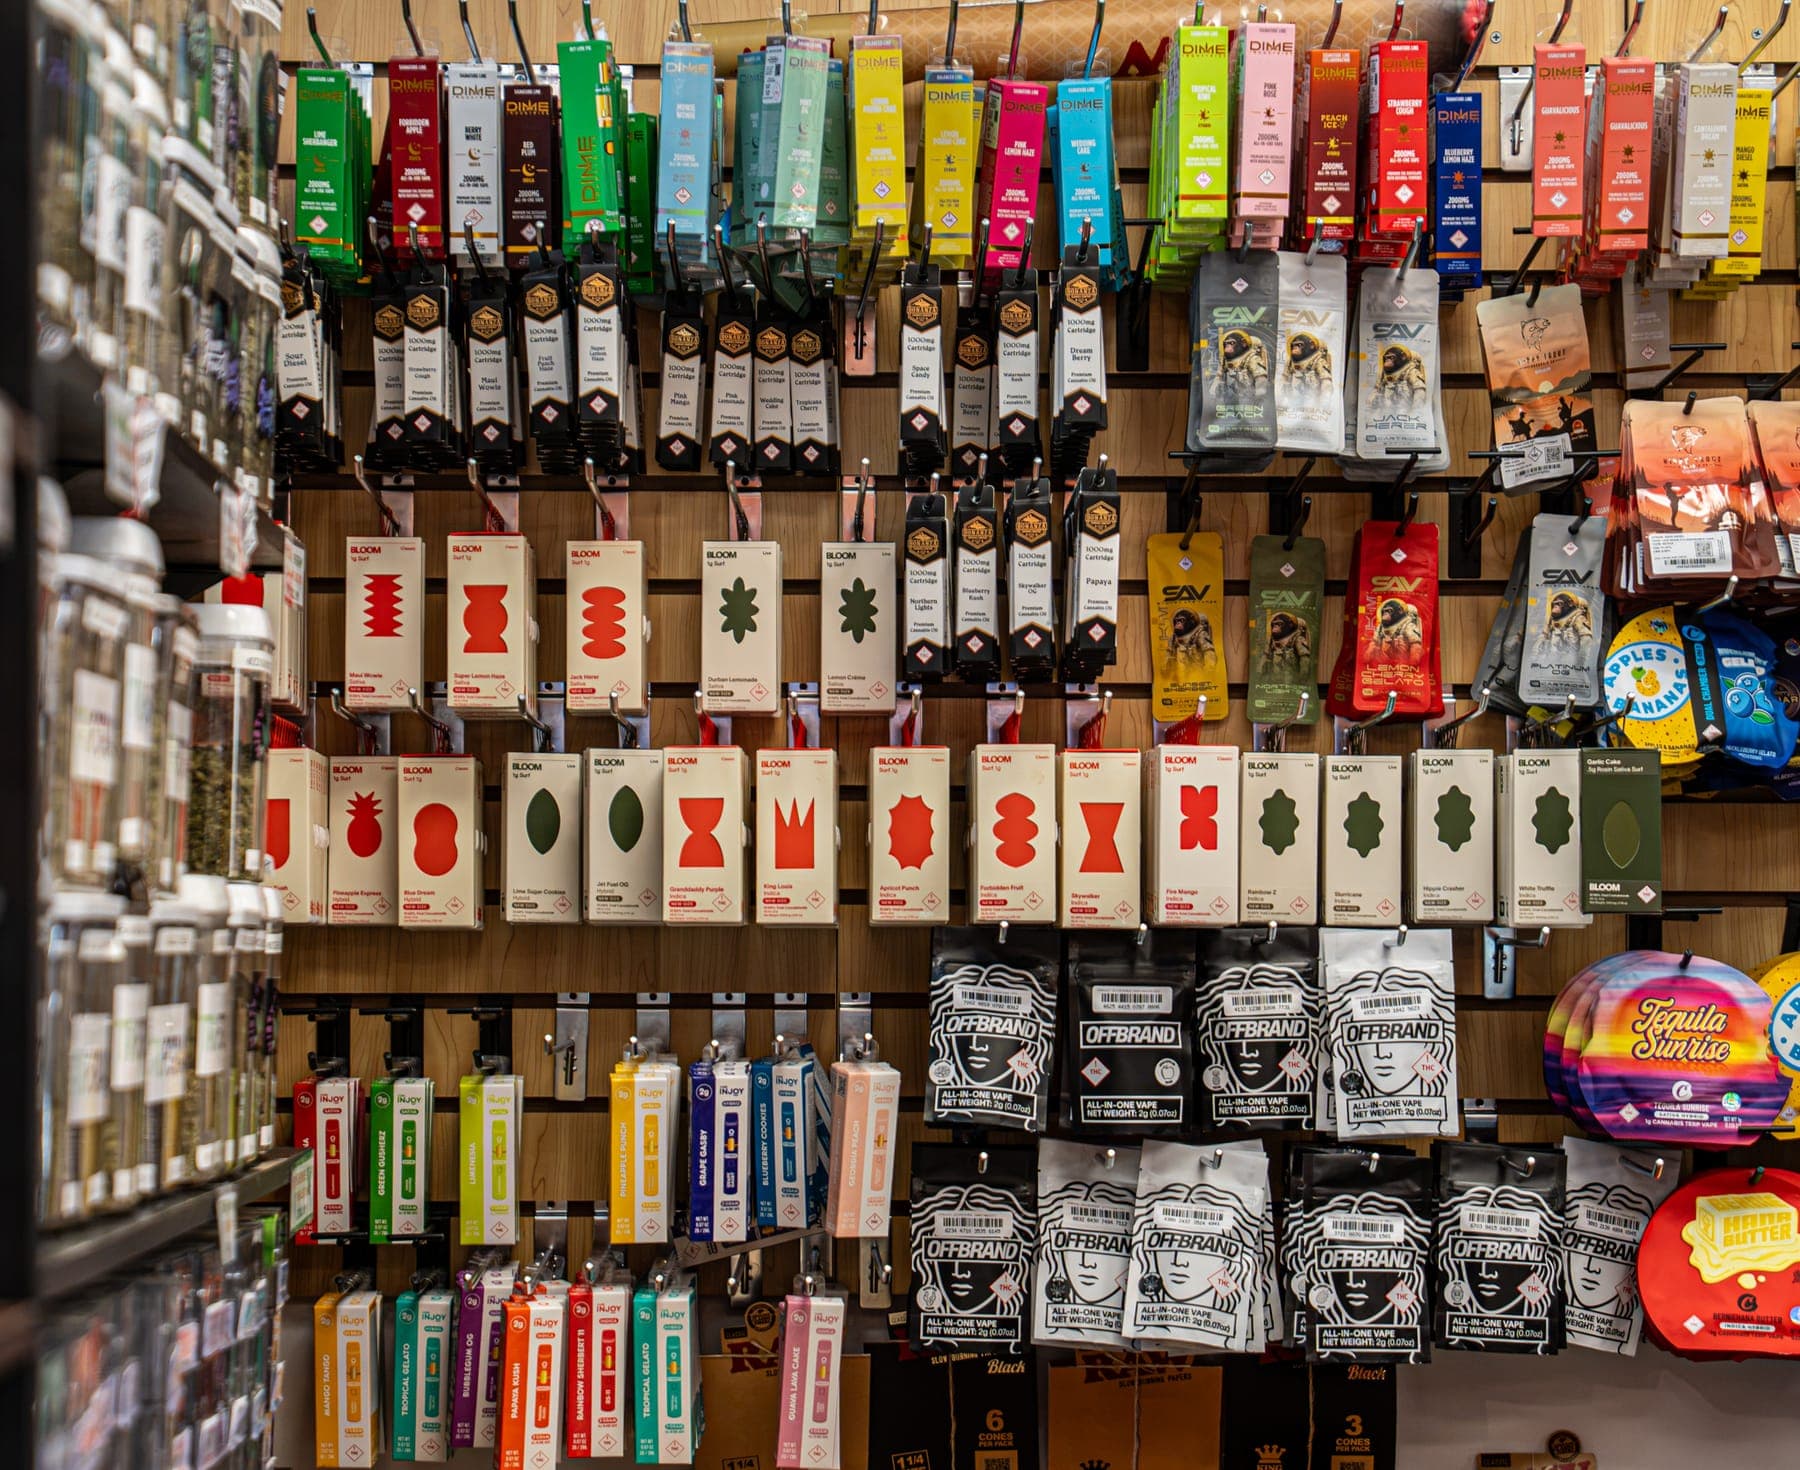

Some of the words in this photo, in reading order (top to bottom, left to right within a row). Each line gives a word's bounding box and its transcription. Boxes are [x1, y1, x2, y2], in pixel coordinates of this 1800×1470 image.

[1182, 43, 1225, 55] DIME
[1250, 40, 1293, 52] DIME
[1313, 66, 1357, 78] DIME
[1539, 67, 1583, 78] DIME
[391, 79, 435, 91] DIME
[452, 84, 495, 96] DIME
[1609, 82, 1651, 93] DIME
[1691, 84, 1734, 95] DIME
[928, 90, 970, 102] DIME
[506, 99, 549, 112] DIME
[1004, 100, 1043, 112] DIME
[1061, 98, 1103, 111] DIME
[1396, 107, 1414, 115] COUGH
[1438, 109, 1480, 120] DIME
[1610, 122, 1648, 130] GUAVALICIOUS
[465, 133, 482, 141] WHITE
[1071, 140, 1096, 149] WEDDING
[521, 148, 536, 156] PLUM
[1736, 153, 1753, 161] DIESEL
[578, 136, 592, 202] DIME
[1213, 306, 1267, 323] SAV
[1280, 310, 1332, 327] SAV
[1372, 323, 1425, 339] SAV
[911, 371, 930, 379] Candy
[707, 551, 737, 559] BLOOM
[1086, 578, 1112, 586] Papaya
[1542, 569, 1594, 584] SAV
[1372, 576, 1423, 592] SAV
[1162, 585, 1210, 602] SAV
[1260, 590, 1310, 606] SAV
[1367, 664, 1420, 672] LEMON
[1531, 663, 1590, 671] PLATINUM
[1605, 648, 1667, 689] APPLES
[1362, 679, 1424, 687] GELATO
[1165, 756, 1197, 764] BLOOM
[1422, 759, 1453, 767] BLOOM
[1519, 759, 1550, 767] BLOOM
[333, 766, 362, 774] BLOOM
[1633, 997, 1729, 1038] Tequila
[946, 1016, 1036, 1039] OFFBRAND
[1214, 1020, 1306, 1039] OFFBRAND
[1349, 1023, 1440, 1042] OFFBRAND
[1086, 1026, 1176, 1043] OFFBRAND
[1633, 1024, 1730, 1062] Sunrise
[1016, 1060, 1029, 1068] THC
[776, 1078, 798, 1086] INJOY
[720, 1087, 744, 1096] INJOY
[320, 1095, 344, 1104] INJOY
[397, 1095, 421, 1105] INJOY
[1218, 1097, 1266, 1106] ALL-IN-ONE
[1268, 1097, 1288, 1105] VAPE
[1682, 1103, 1709, 1112] SUNRISE
[1087, 1109, 1101, 1117] NET
[1102, 1109, 1137, 1117] WEIGHT:
[1139, 1110, 1148, 1119] 2g
[1150, 1109, 1177, 1119] (0.07oz)
[760, 1103, 768, 1139] COOKIES
[700, 1130, 708, 1158] GASBY
[1724, 1212, 1792, 1233] HANA
[1724, 1223, 1791, 1247] BUTTER
[1146, 1230, 1239, 1257] OFFBRAND
[926, 1240, 1019, 1260] OFFBRAND
[1453, 1239, 1545, 1261] OFFBRAND
[1319, 1249, 1414, 1269] OFFBRAND
[596, 1304, 621, 1314] INJOY
[660, 1310, 685, 1320] INJOY
[422, 1313, 446, 1321] INJOY
[578, 1338, 586, 1378] SHERBERT
[987, 1359, 1026, 1374] Black
[1347, 1364, 1387, 1381] Black
[512, 1363, 520, 1388] KUSH
[1167, 1373, 1192, 1382] PAPERS
[576, 1379, 585, 1420] RAINBOW
[986, 1409, 1004, 1432] 6
[1345, 1415, 1363, 1436] 3
[978, 1432, 1013, 1441] CONES
[1336, 1438, 1370, 1446] CONES
